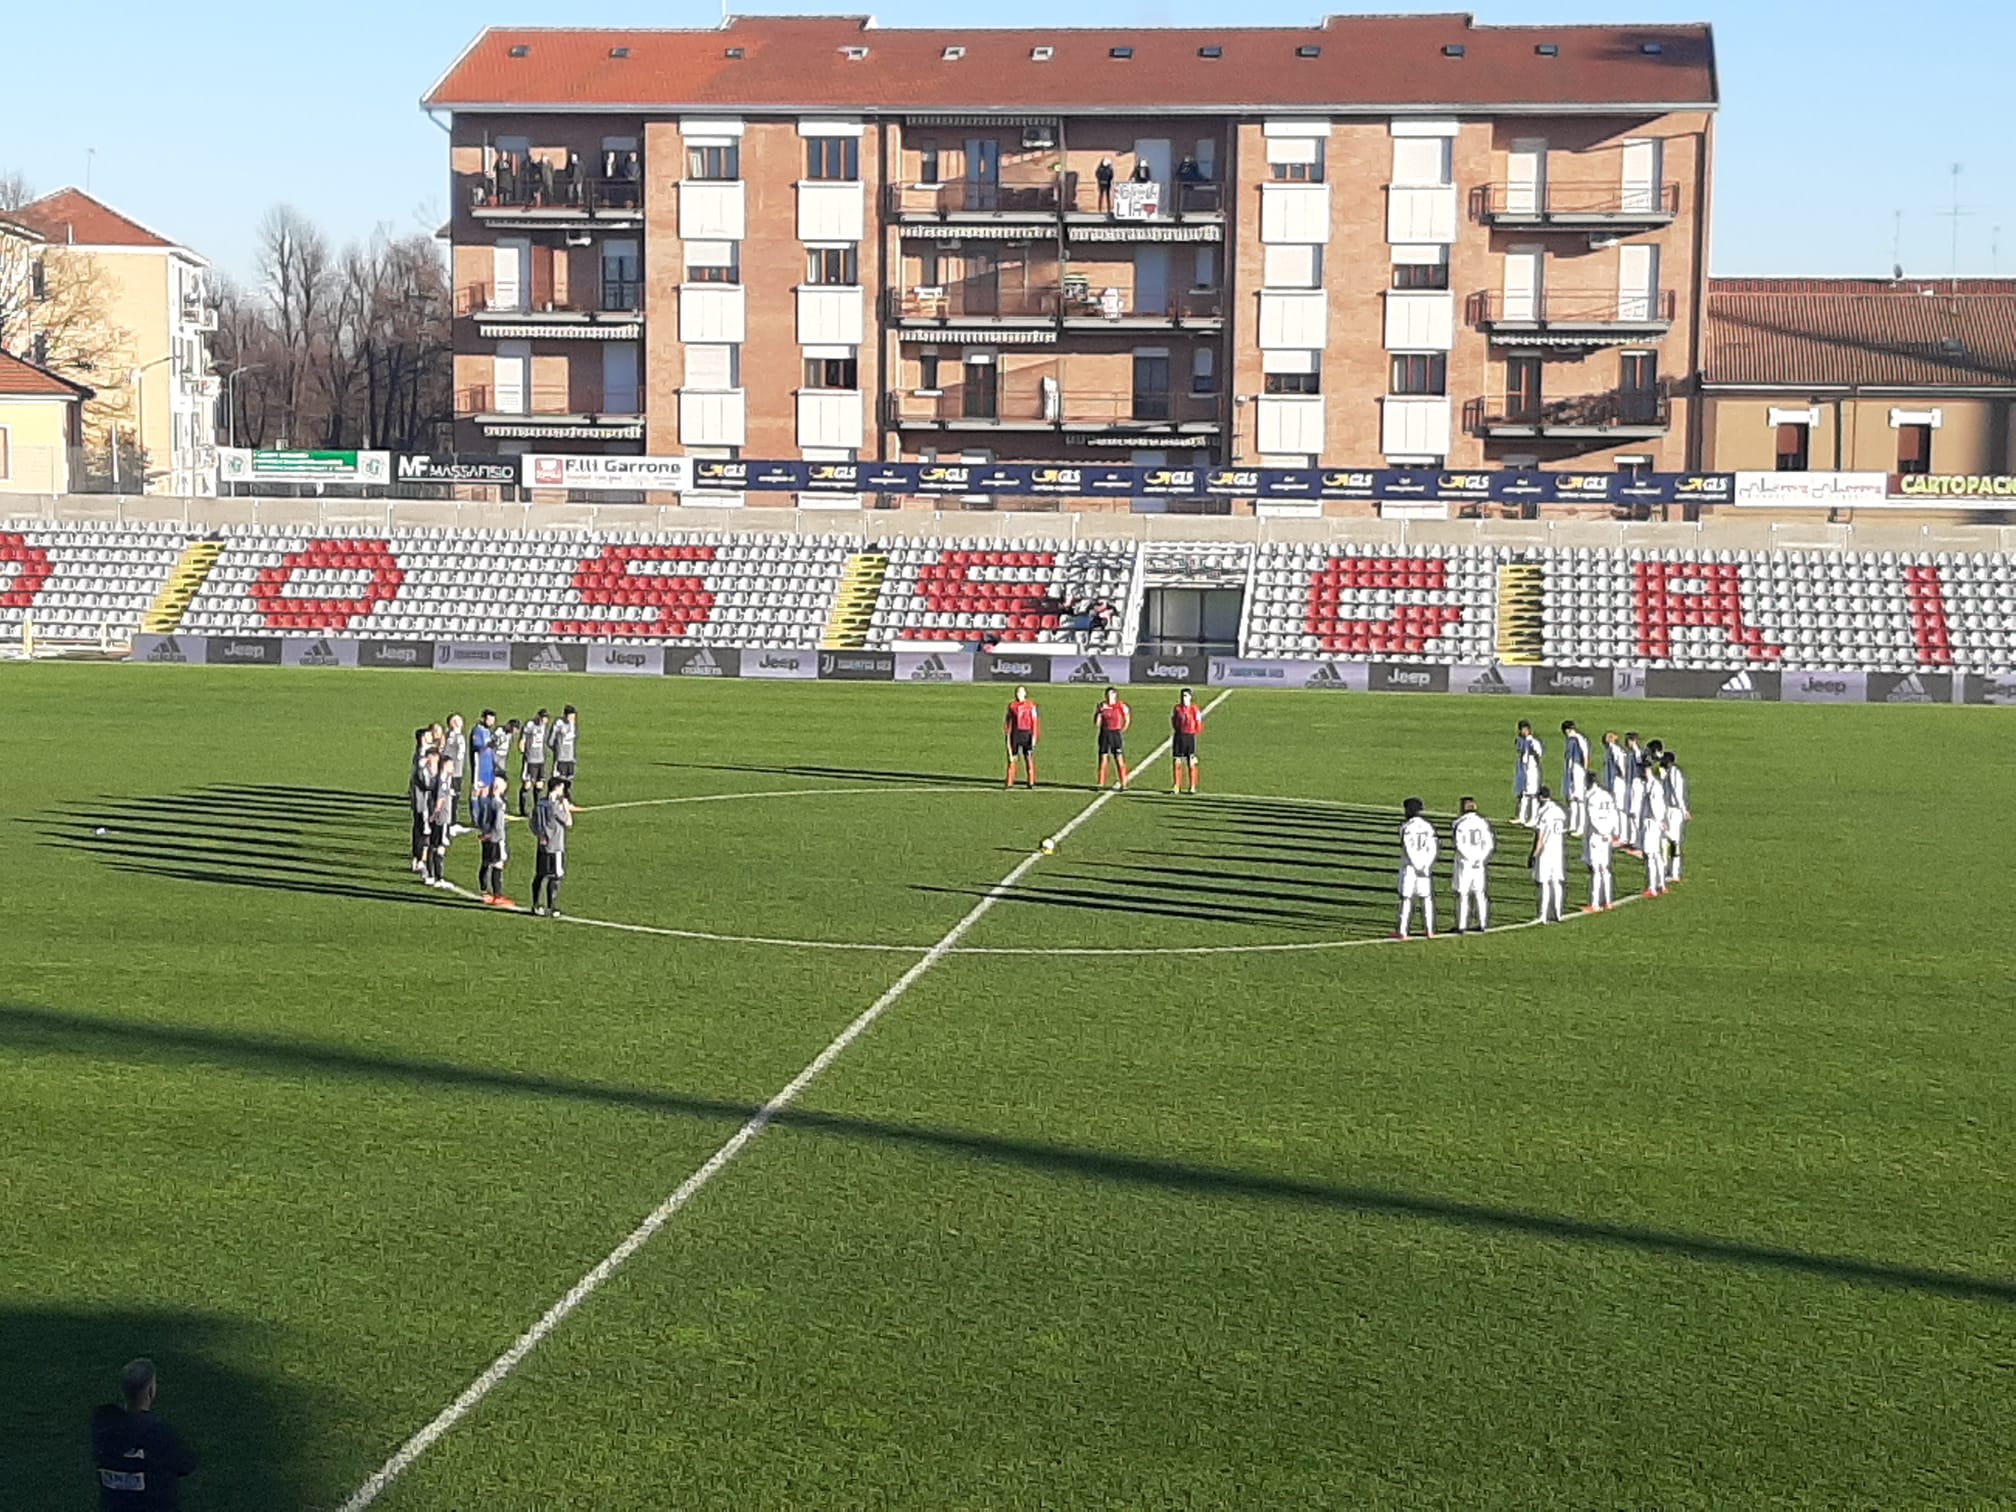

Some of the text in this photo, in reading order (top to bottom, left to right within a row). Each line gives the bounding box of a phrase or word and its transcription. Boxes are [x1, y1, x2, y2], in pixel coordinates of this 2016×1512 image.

[398, 455, 430, 477] MF
[604, 459, 681, 474] Garrone
[224, 641, 264, 659] Jeep
[376, 645, 416, 662] Jeep
[604, 650, 646, 667] Jeep
[759, 654, 800, 671] Jeep
[990, 660, 1032, 677] Jeep
[1146, 662, 1189, 679] Jeep
[1388, 668, 1431, 687] Jeep
[1550, 672, 1594, 689] Jeep
[1801, 677, 1846, 696] Jeep
